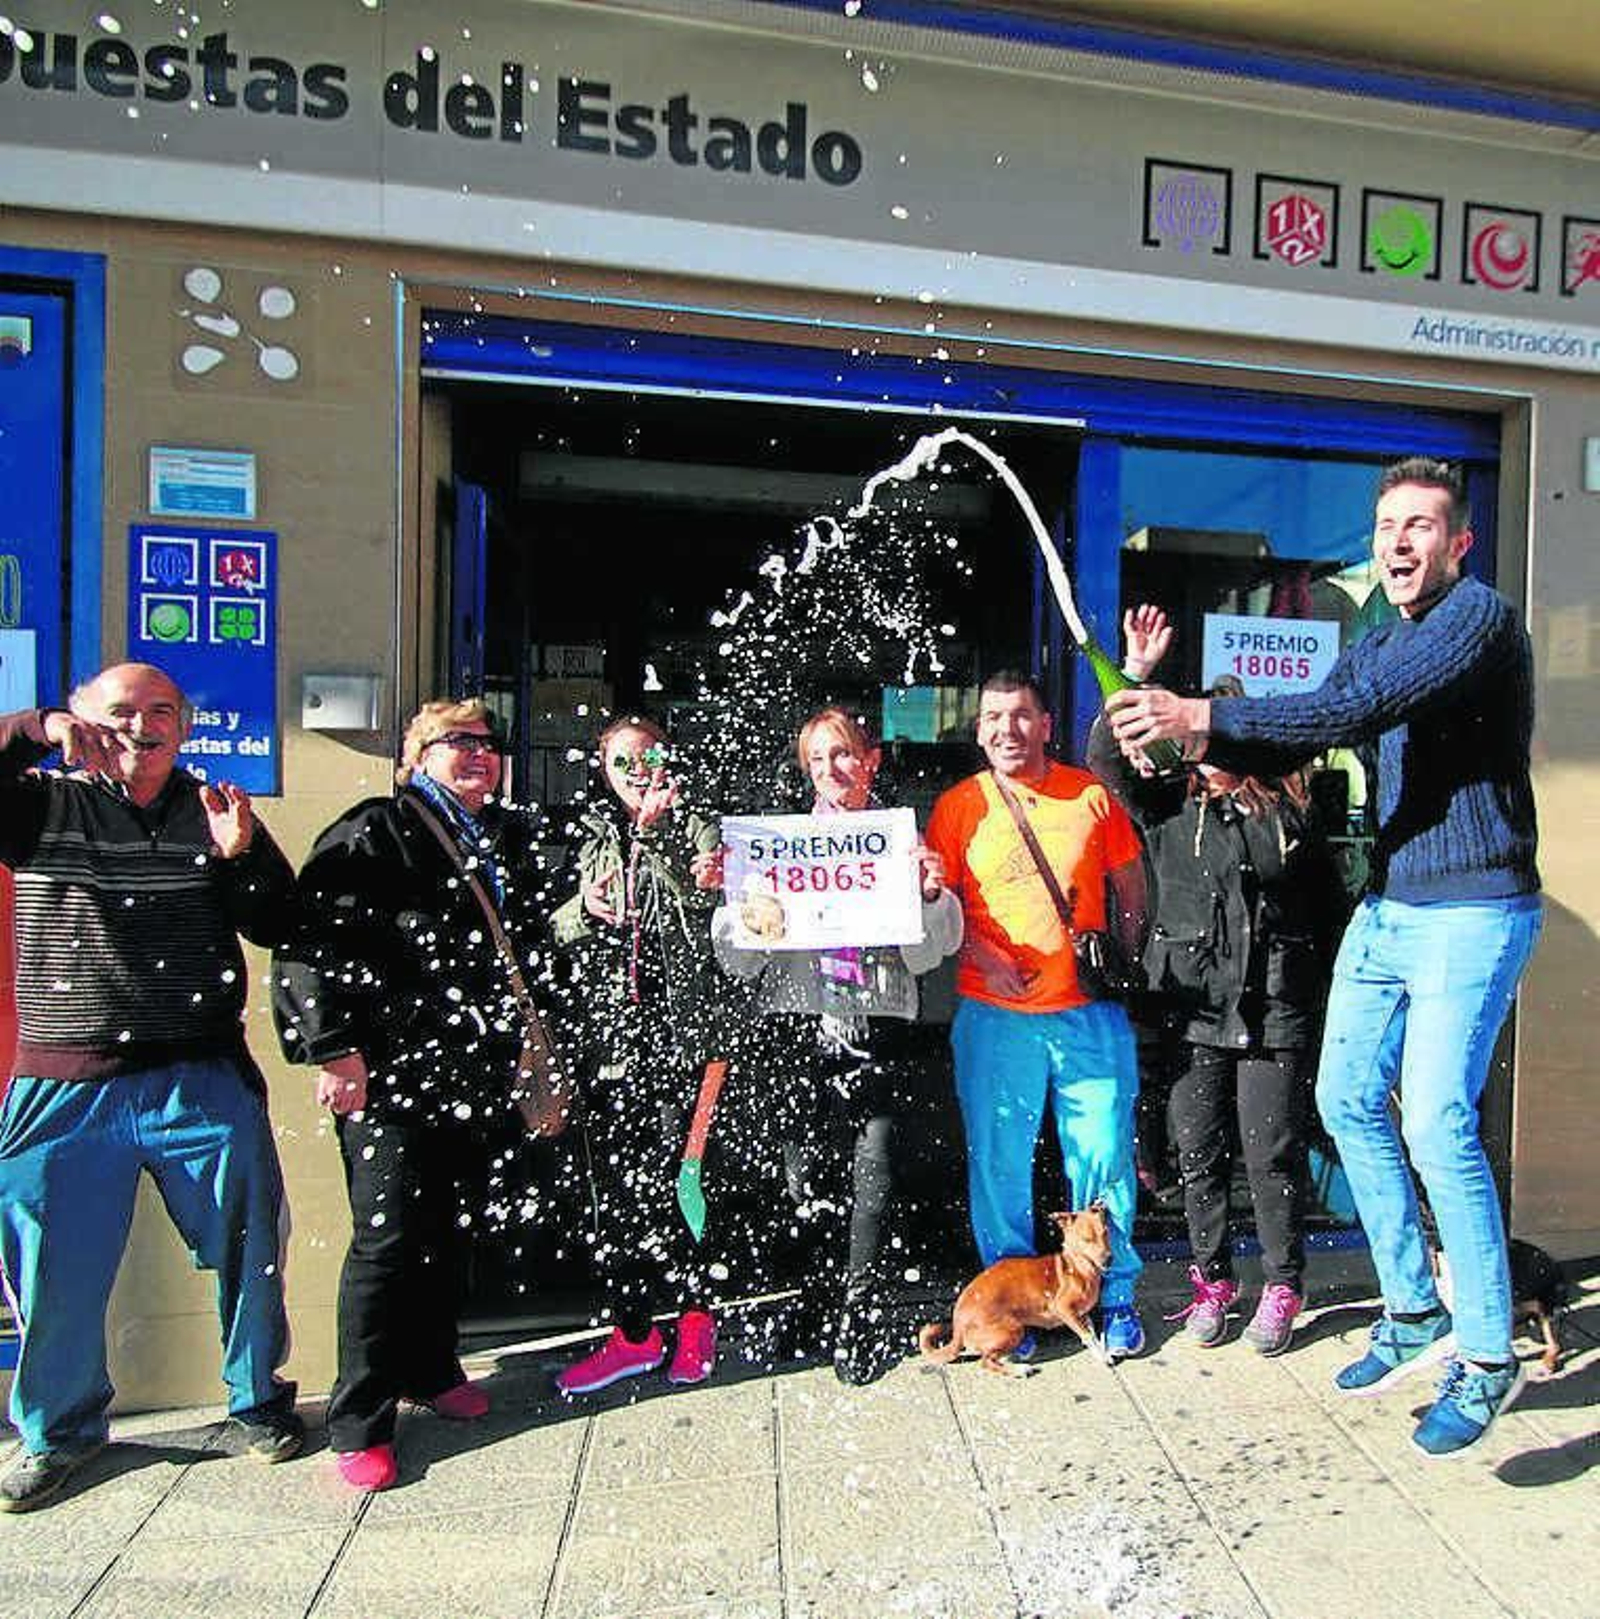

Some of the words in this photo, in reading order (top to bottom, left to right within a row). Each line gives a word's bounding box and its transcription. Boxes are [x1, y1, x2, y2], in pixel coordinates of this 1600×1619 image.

[384, 51, 525, 144] del
[557, 77, 862, 187] Estado
[1412, 316, 1585, 357] Administración
[1223, 631, 1235, 650] 5
[1240, 632, 1319, 654] PREMIO
[1233, 654, 1310, 679] 18065
[226, 711, 240, 732] y
[237, 735, 270, 756] del
[750, 838, 765, 861] 5
[772, 833, 887, 859] PREMIO
[765, 862, 876, 893] 18065
